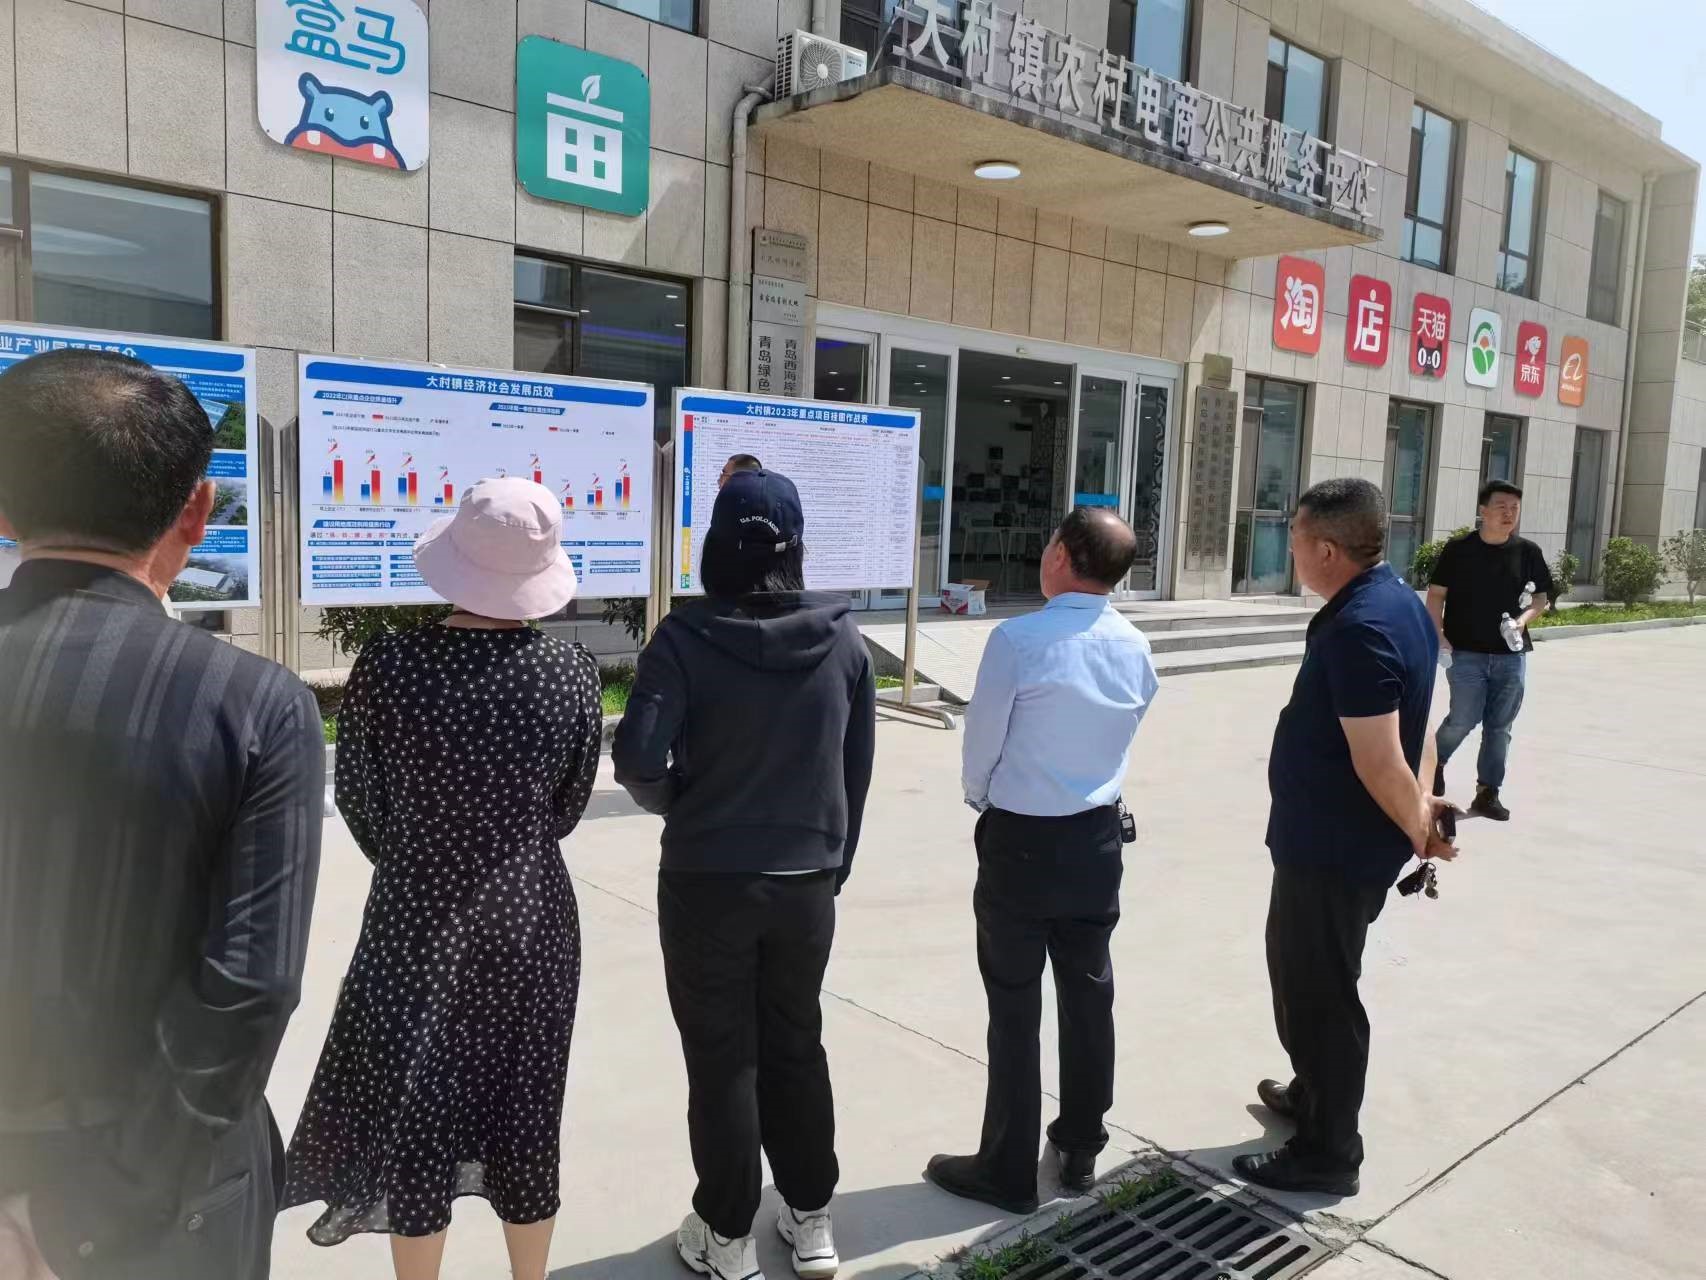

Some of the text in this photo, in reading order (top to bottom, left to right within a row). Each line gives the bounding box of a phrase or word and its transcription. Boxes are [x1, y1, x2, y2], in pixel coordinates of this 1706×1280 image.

[285, 0, 406, 75] 盒马
[1281, 276, 1319, 335] 淘
[1353, 289, 1385, 353] 店
[1417, 308, 1447, 340] 天猫
[758, 335, 771, 395] 青岛绿色
[1520, 364, 1541, 385] 京东
[426, 375, 554, 398] 大村镇经济社会发展成效
[746, 404, 869, 424] 大村镇2023年重点项目挂图作战表
[751, 515, 769, 523] POLO
